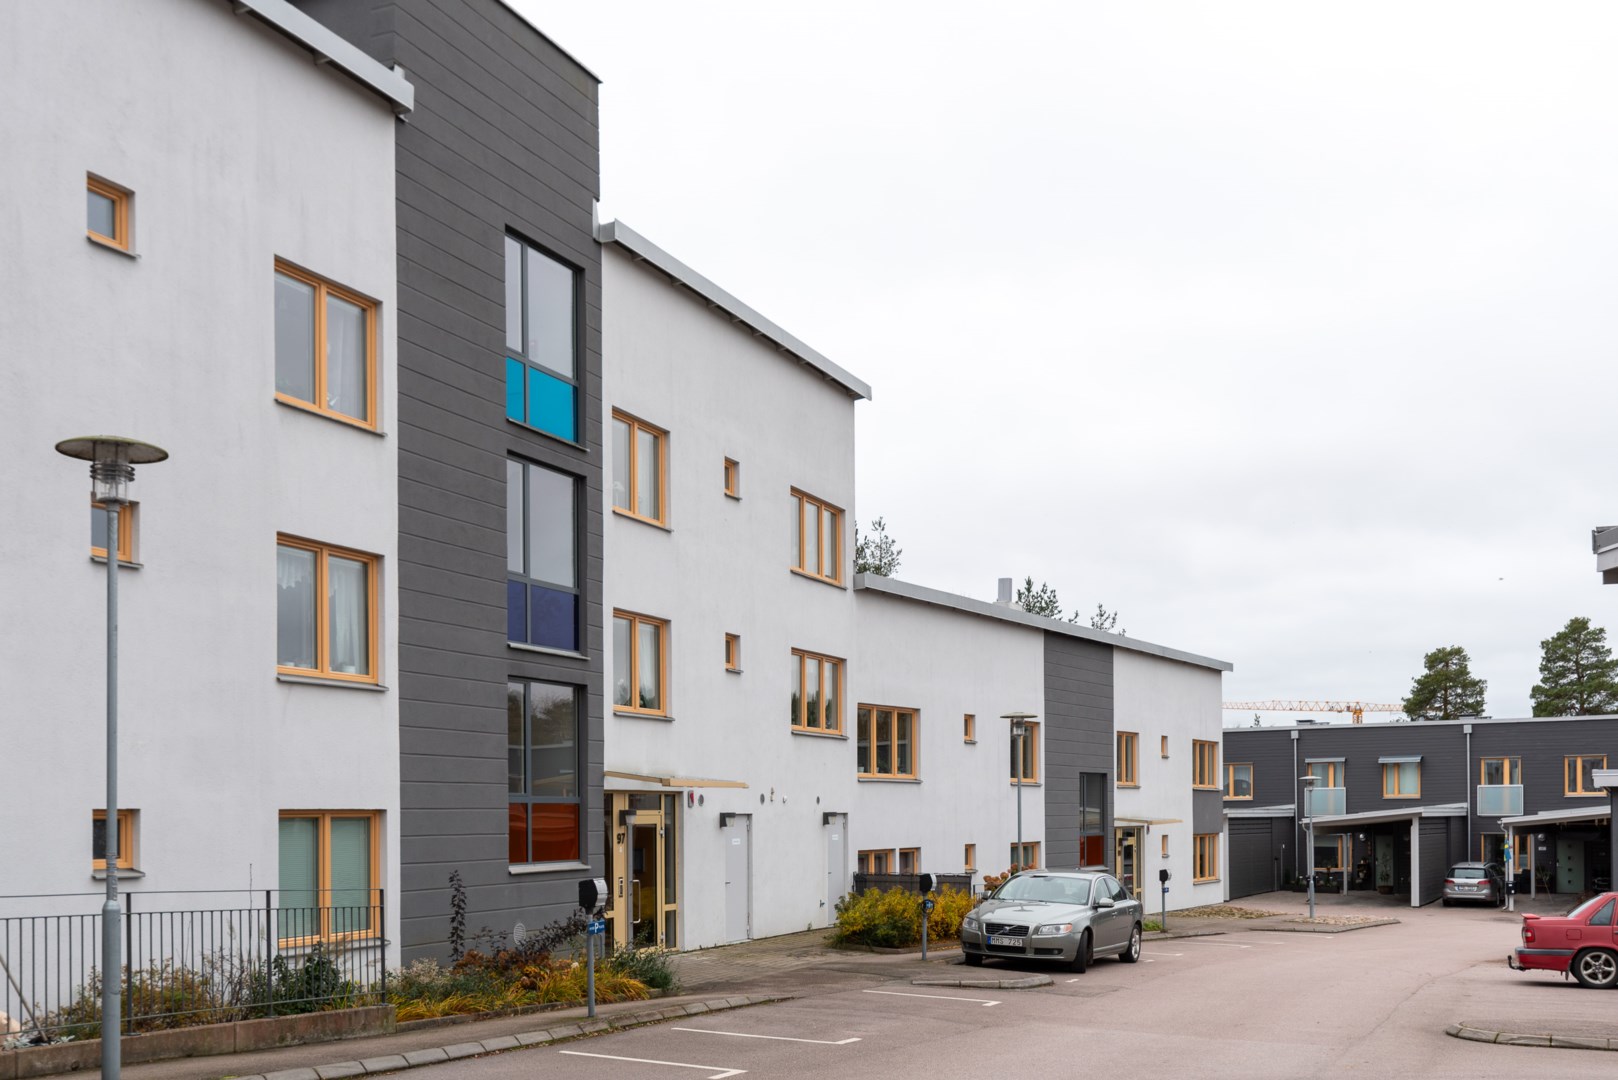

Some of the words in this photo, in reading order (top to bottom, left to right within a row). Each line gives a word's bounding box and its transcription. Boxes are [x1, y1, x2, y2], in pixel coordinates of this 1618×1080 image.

[617, 833, 625, 844] 97
[595, 922, 599, 933] P
[1008, 938, 1021, 946] 725
